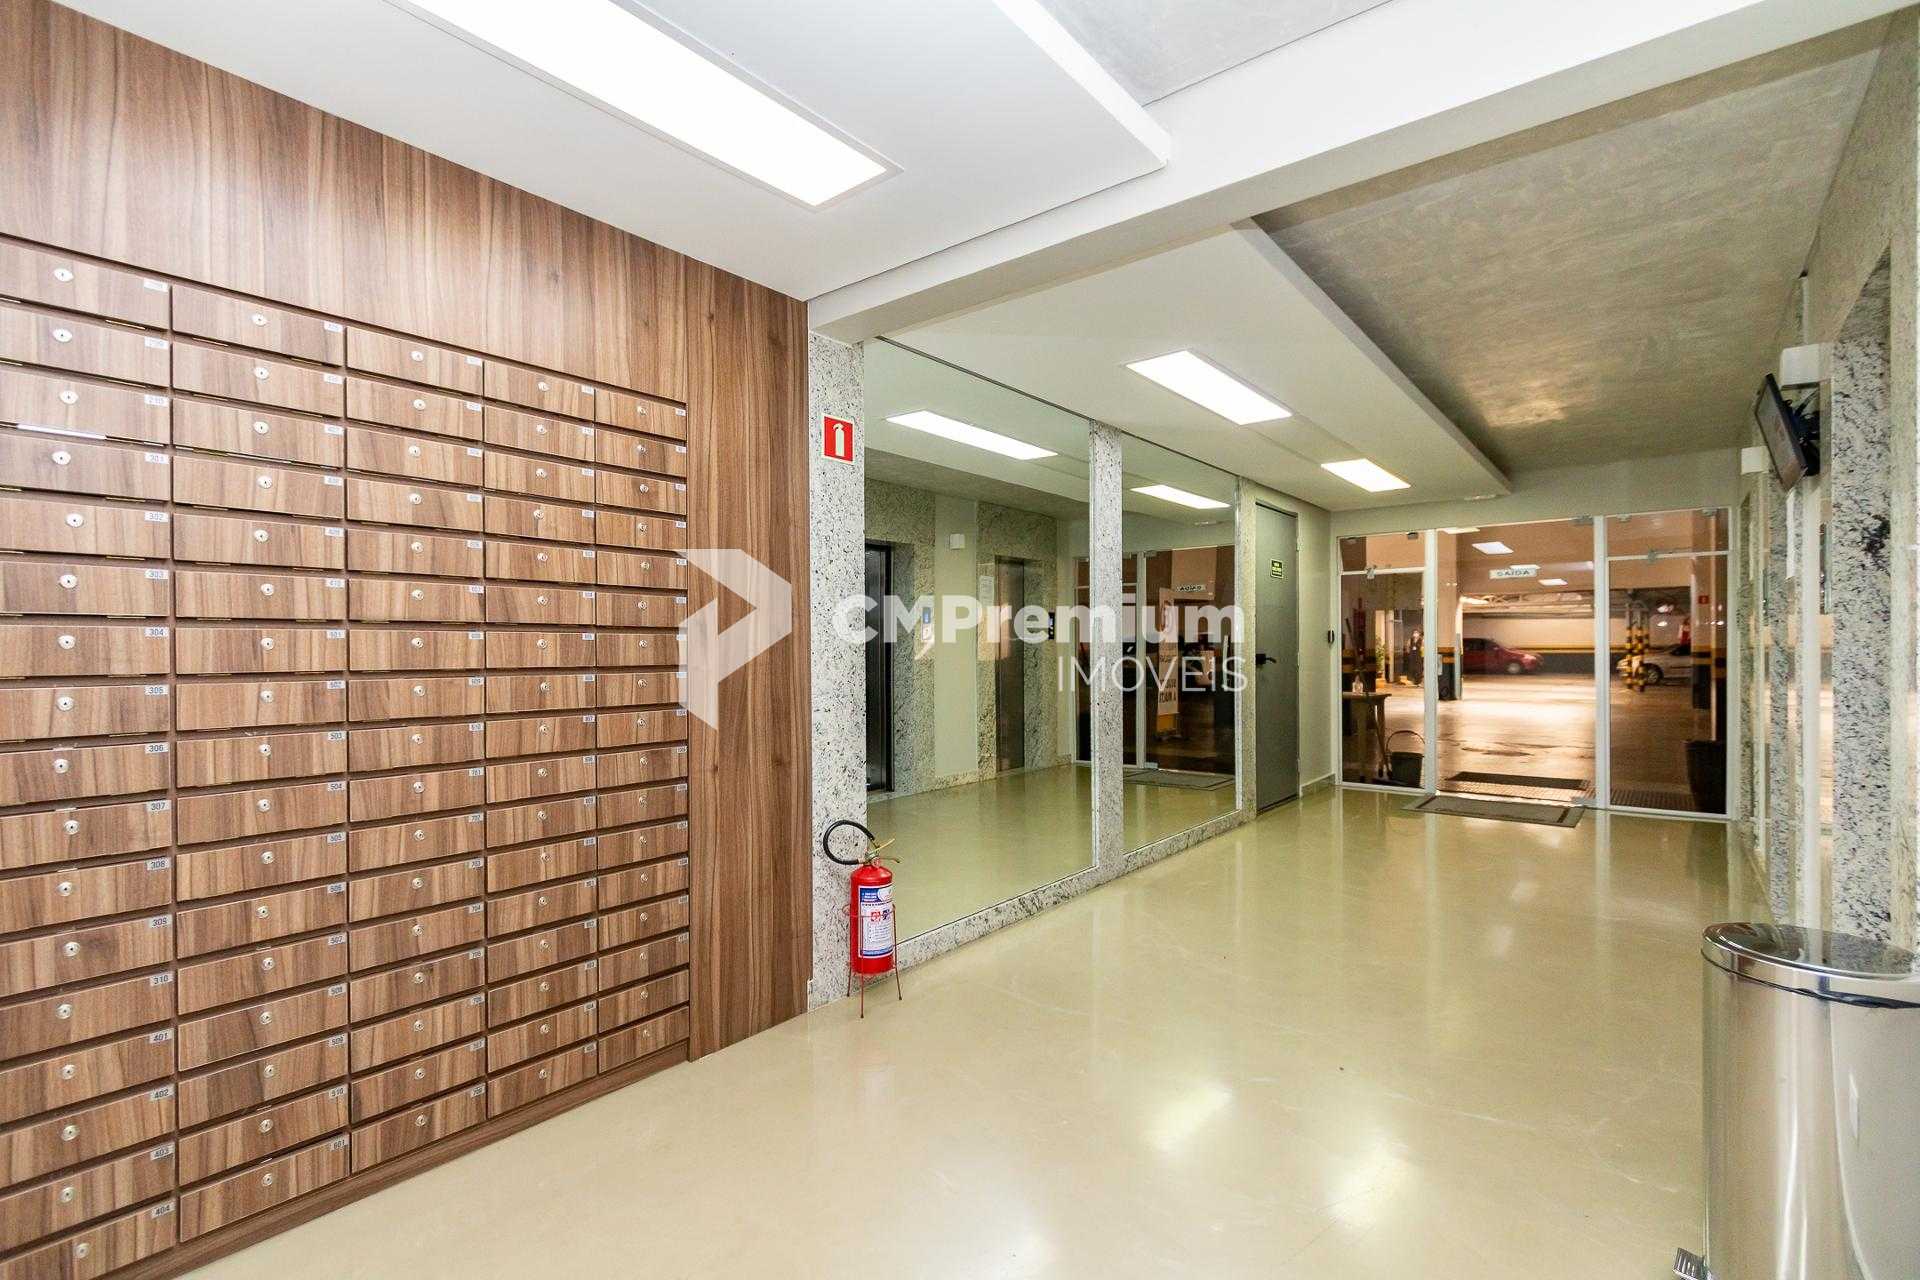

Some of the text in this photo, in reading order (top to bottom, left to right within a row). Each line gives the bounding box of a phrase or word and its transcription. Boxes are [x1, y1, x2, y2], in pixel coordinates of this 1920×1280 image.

[150, 570, 164, 578] 303
[151, 802, 165, 811] 307
[151, 860, 165, 869] 308
[153, 918, 167, 927] 309
[154, 976, 169, 984] 310
[153, 1033, 168, 1041] 401
[154, 1089, 169, 1098] 402
[154, 1148, 169, 1157] 403
[155, 1205, 170, 1216] 404
